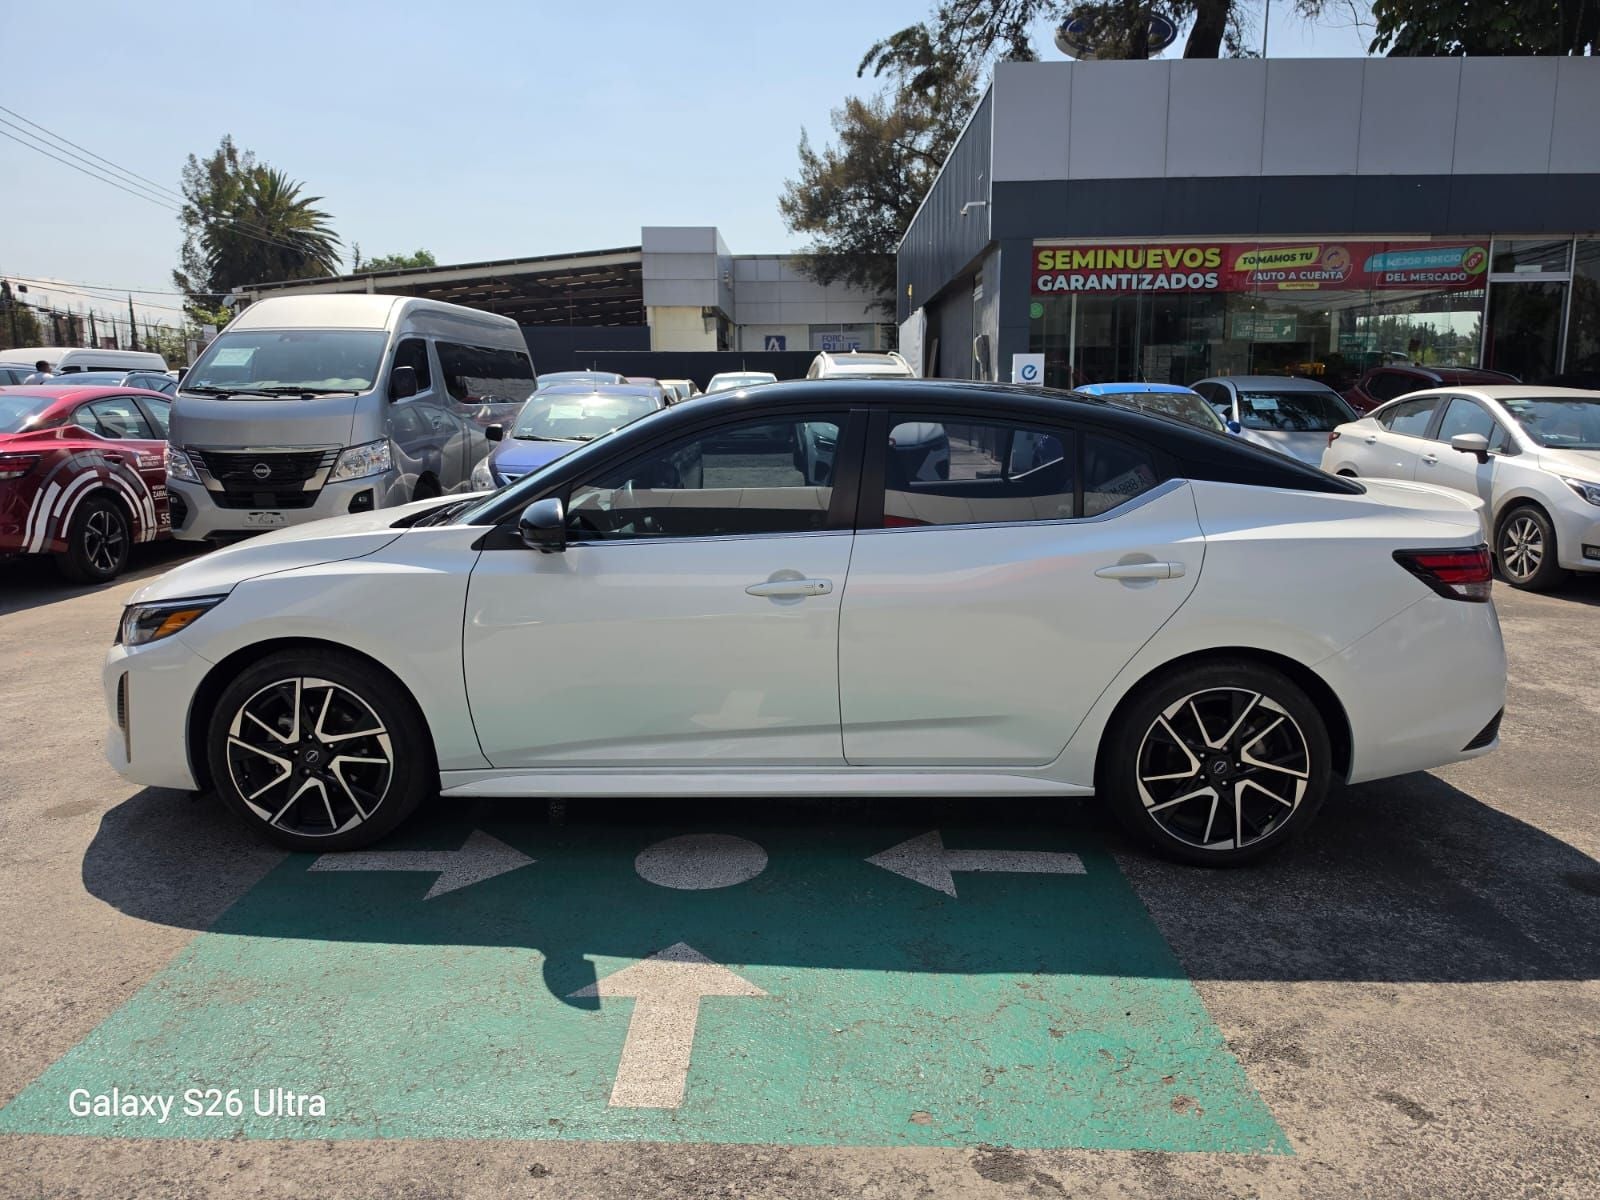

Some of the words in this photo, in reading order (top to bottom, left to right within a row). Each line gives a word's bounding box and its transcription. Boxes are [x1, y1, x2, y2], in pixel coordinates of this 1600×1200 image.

[1037, 248, 1221, 271] SEMINUEVOS
[1242, 253, 1297, 265] TOMAMOS
[1300, 252, 1313, 261] TU
[1387, 256, 1422, 267] MEJOR
[1424, 254, 1461, 265] PRECIO
[1037, 272, 1219, 291] GARANTIZADOS
[1253, 271, 1286, 281] AUTO
[1288, 271, 1297, 280] A
[1300, 271, 1344, 280] CUENTA
[1386, 273, 1408, 282] DEL
[1410, 272, 1467, 281] MERCADO
